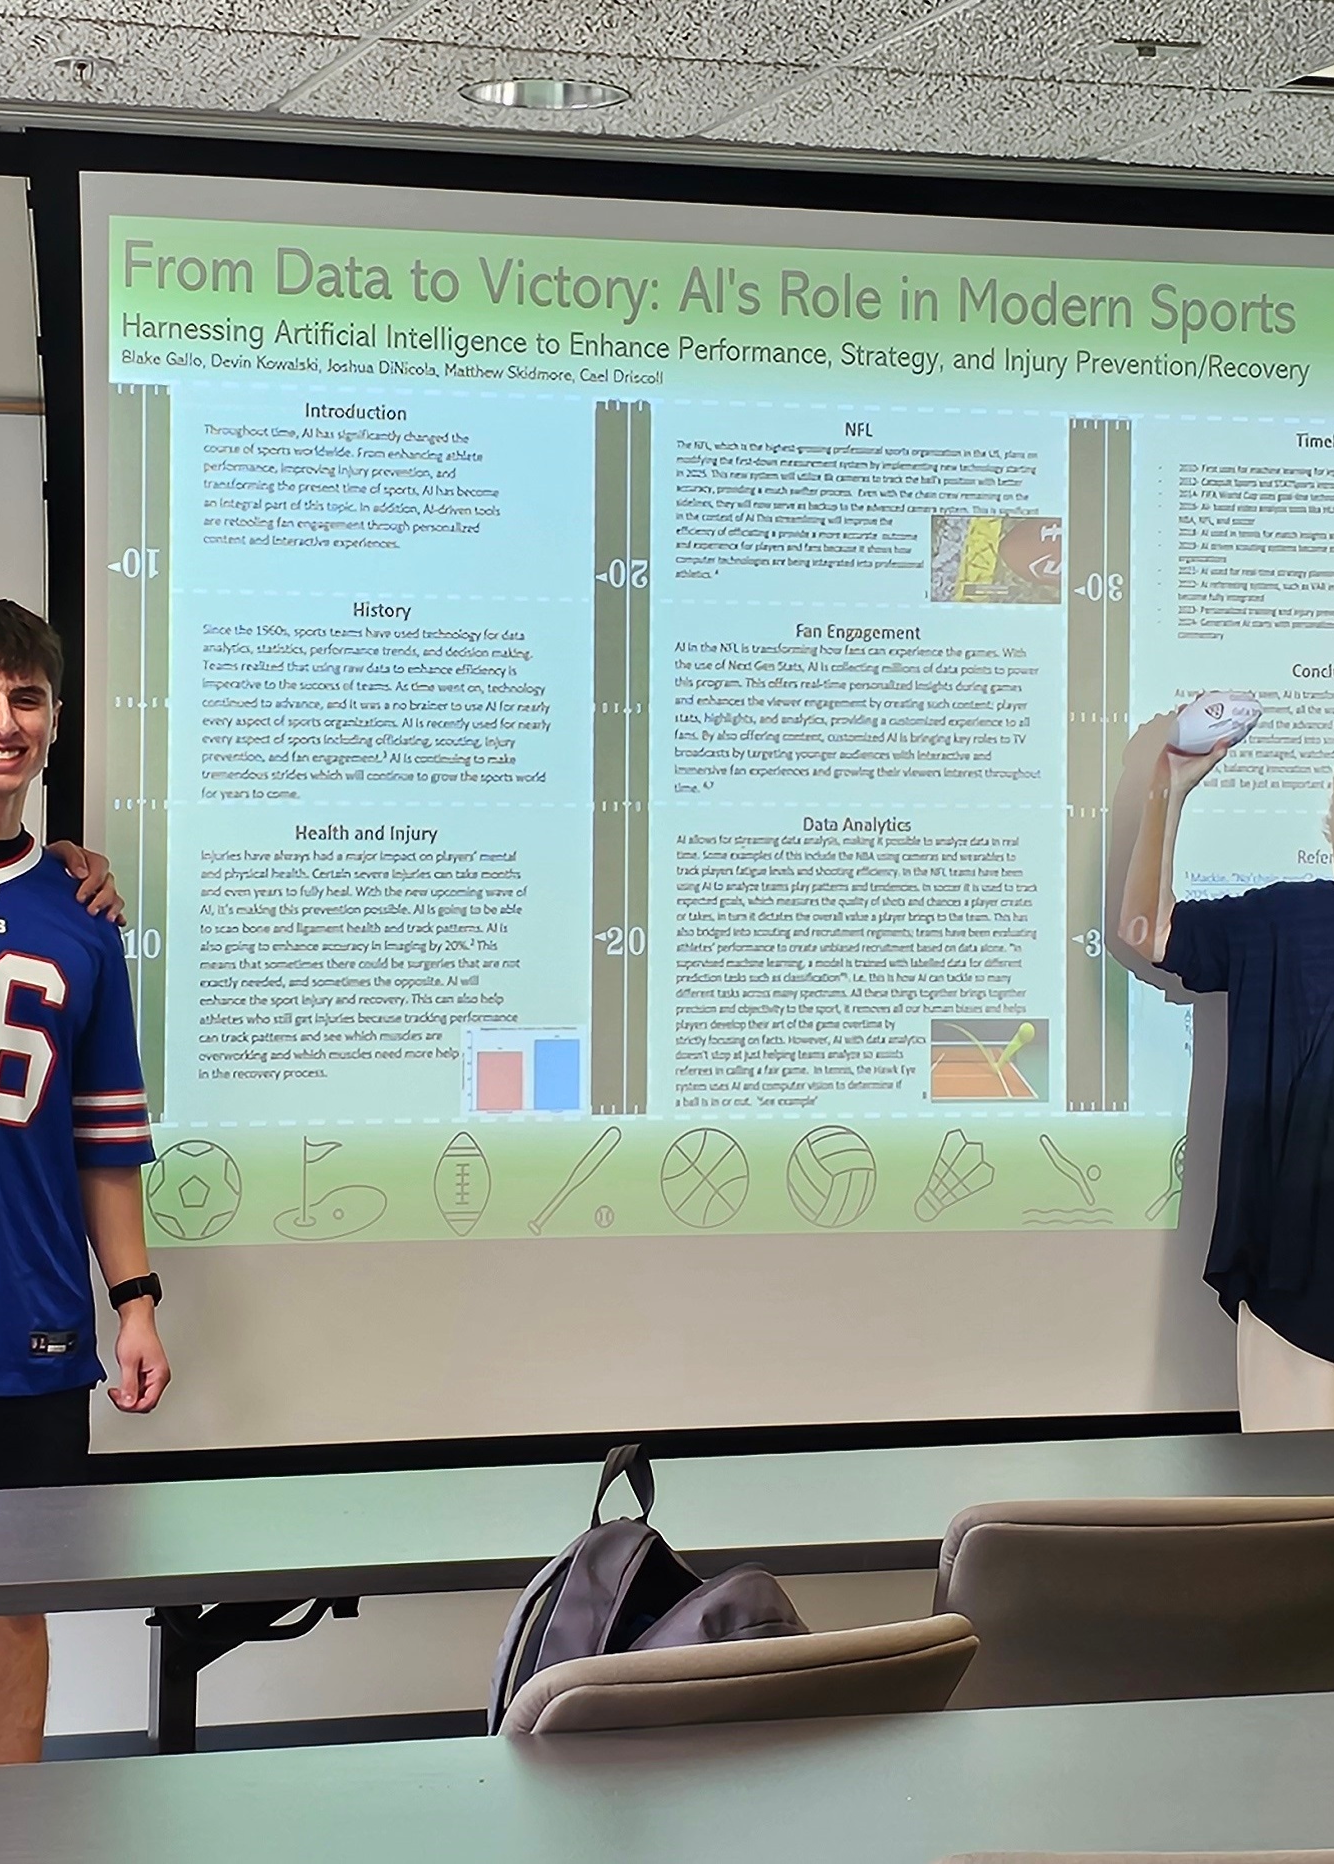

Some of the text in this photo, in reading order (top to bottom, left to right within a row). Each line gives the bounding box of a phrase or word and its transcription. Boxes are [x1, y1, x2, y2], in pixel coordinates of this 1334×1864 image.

[125, 239, 1296, 344] From Data to Victory: AI's Role in Modern Sports
[122, 313, 1311, 387] Harnessing Artificial Intelligence to Enhance Performance, Strategy, and Injury Prevention/Recovery
[121, 348, 663, 385] Blake Gallo, Devin Kowalski, Joshua DiNicola, Matthew Skidmore, Cael Driscoll
[305, 401, 407, 421] Introduction
[845, 420, 873, 437] NFL
[353, 600, 412, 622] History
[795, 622, 921, 643] Fan Engagement
[295, 822, 438, 845] Health and Injury
[803, 816, 913, 834] Data Analytics
[124, 929, 161, 958] 10
[606, 927, 645, 956] 20
